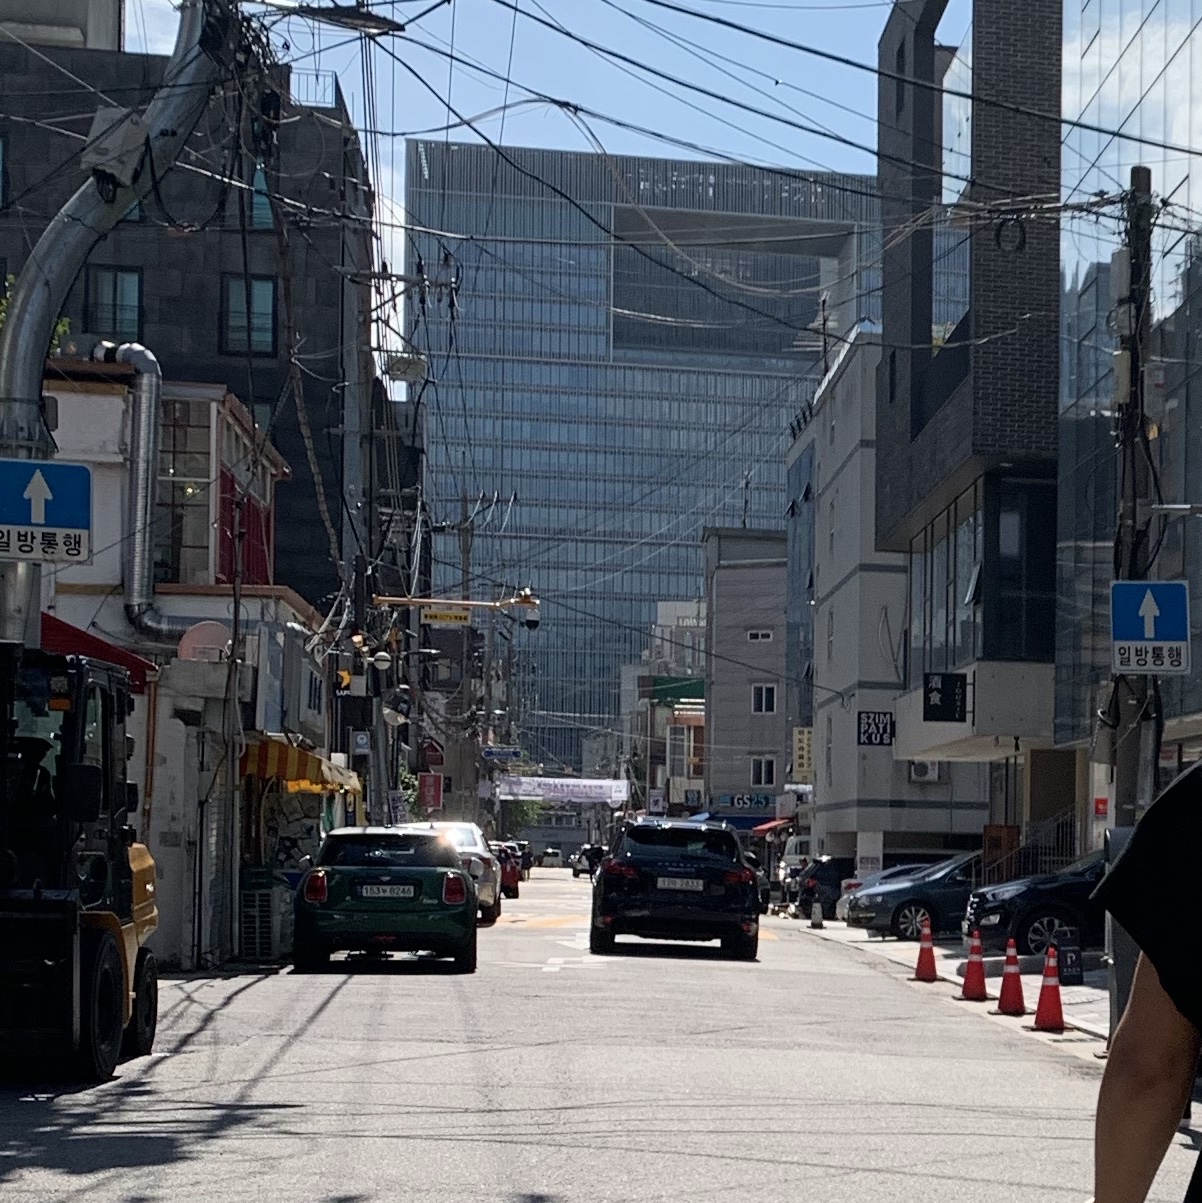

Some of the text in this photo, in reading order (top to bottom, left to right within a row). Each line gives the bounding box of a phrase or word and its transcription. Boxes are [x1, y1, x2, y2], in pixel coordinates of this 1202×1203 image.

[0, 529, 81, 556] 일방통행
[1118, 646, 1182, 667] 일방통행
[860, 712, 891, 724] SZIM
[860, 723, 891, 734] PATI
[860, 733, 891, 744] KUS
[733, 794, 767, 809] GS25
